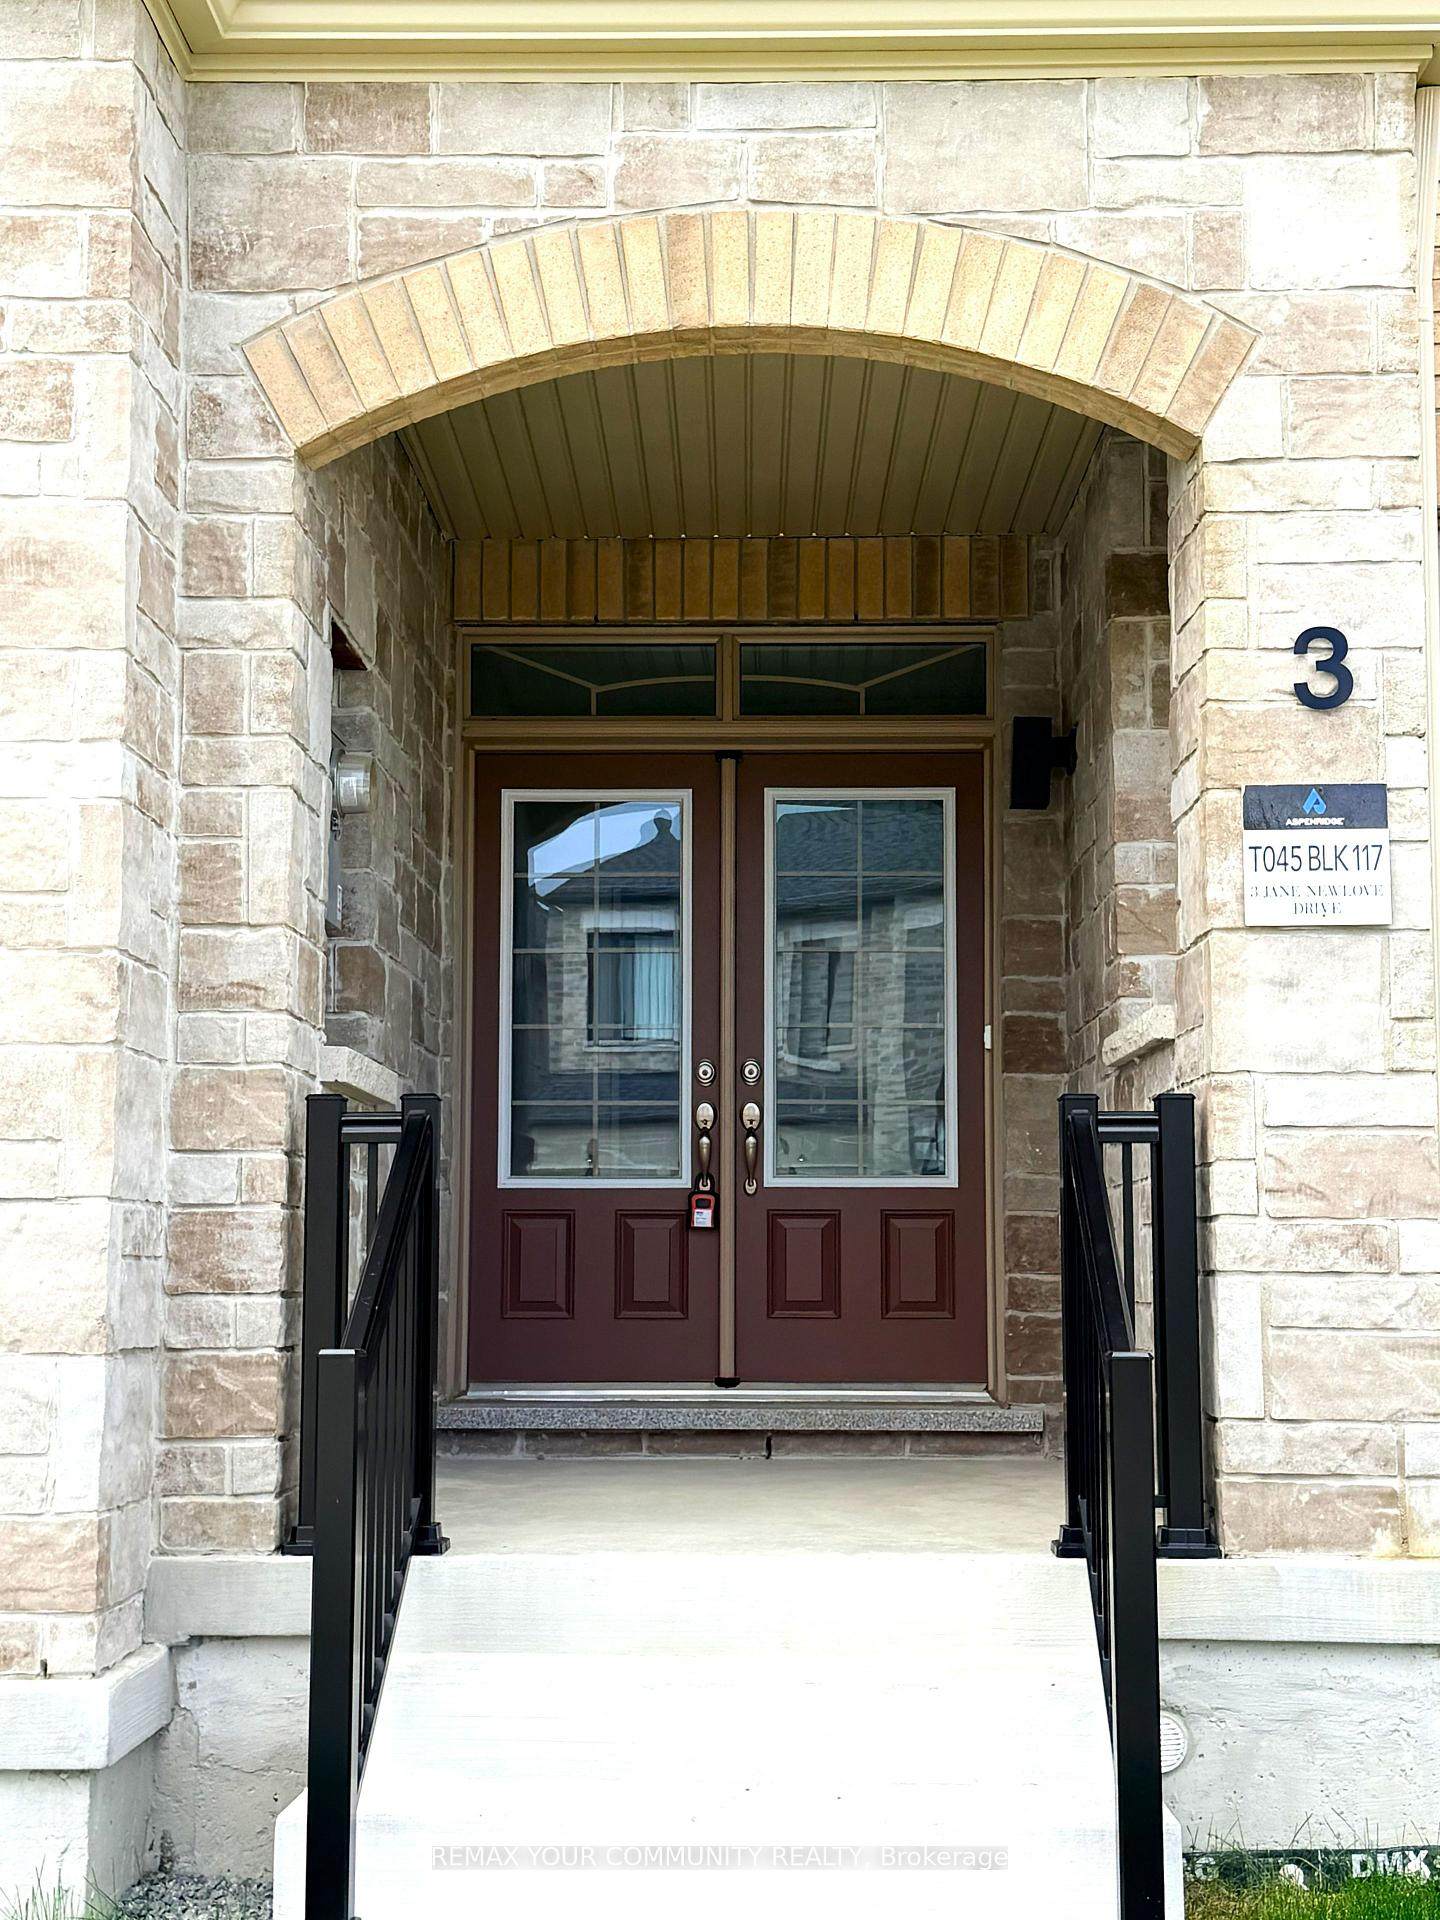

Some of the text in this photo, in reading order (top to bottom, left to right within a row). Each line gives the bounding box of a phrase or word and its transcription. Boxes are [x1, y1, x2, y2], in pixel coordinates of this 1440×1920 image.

[1294, 626, 1353, 709] 3
[1285, 817, 1345, 826] ASPENRIDGE
[1248, 844, 1383, 872] T045 BLK 117
[1250, 884, 1384, 898] 3 JANE NEWLOVE
[1294, 902, 1342, 915] DRIVE
[1352, 1849, 1431, 1880] DMX
